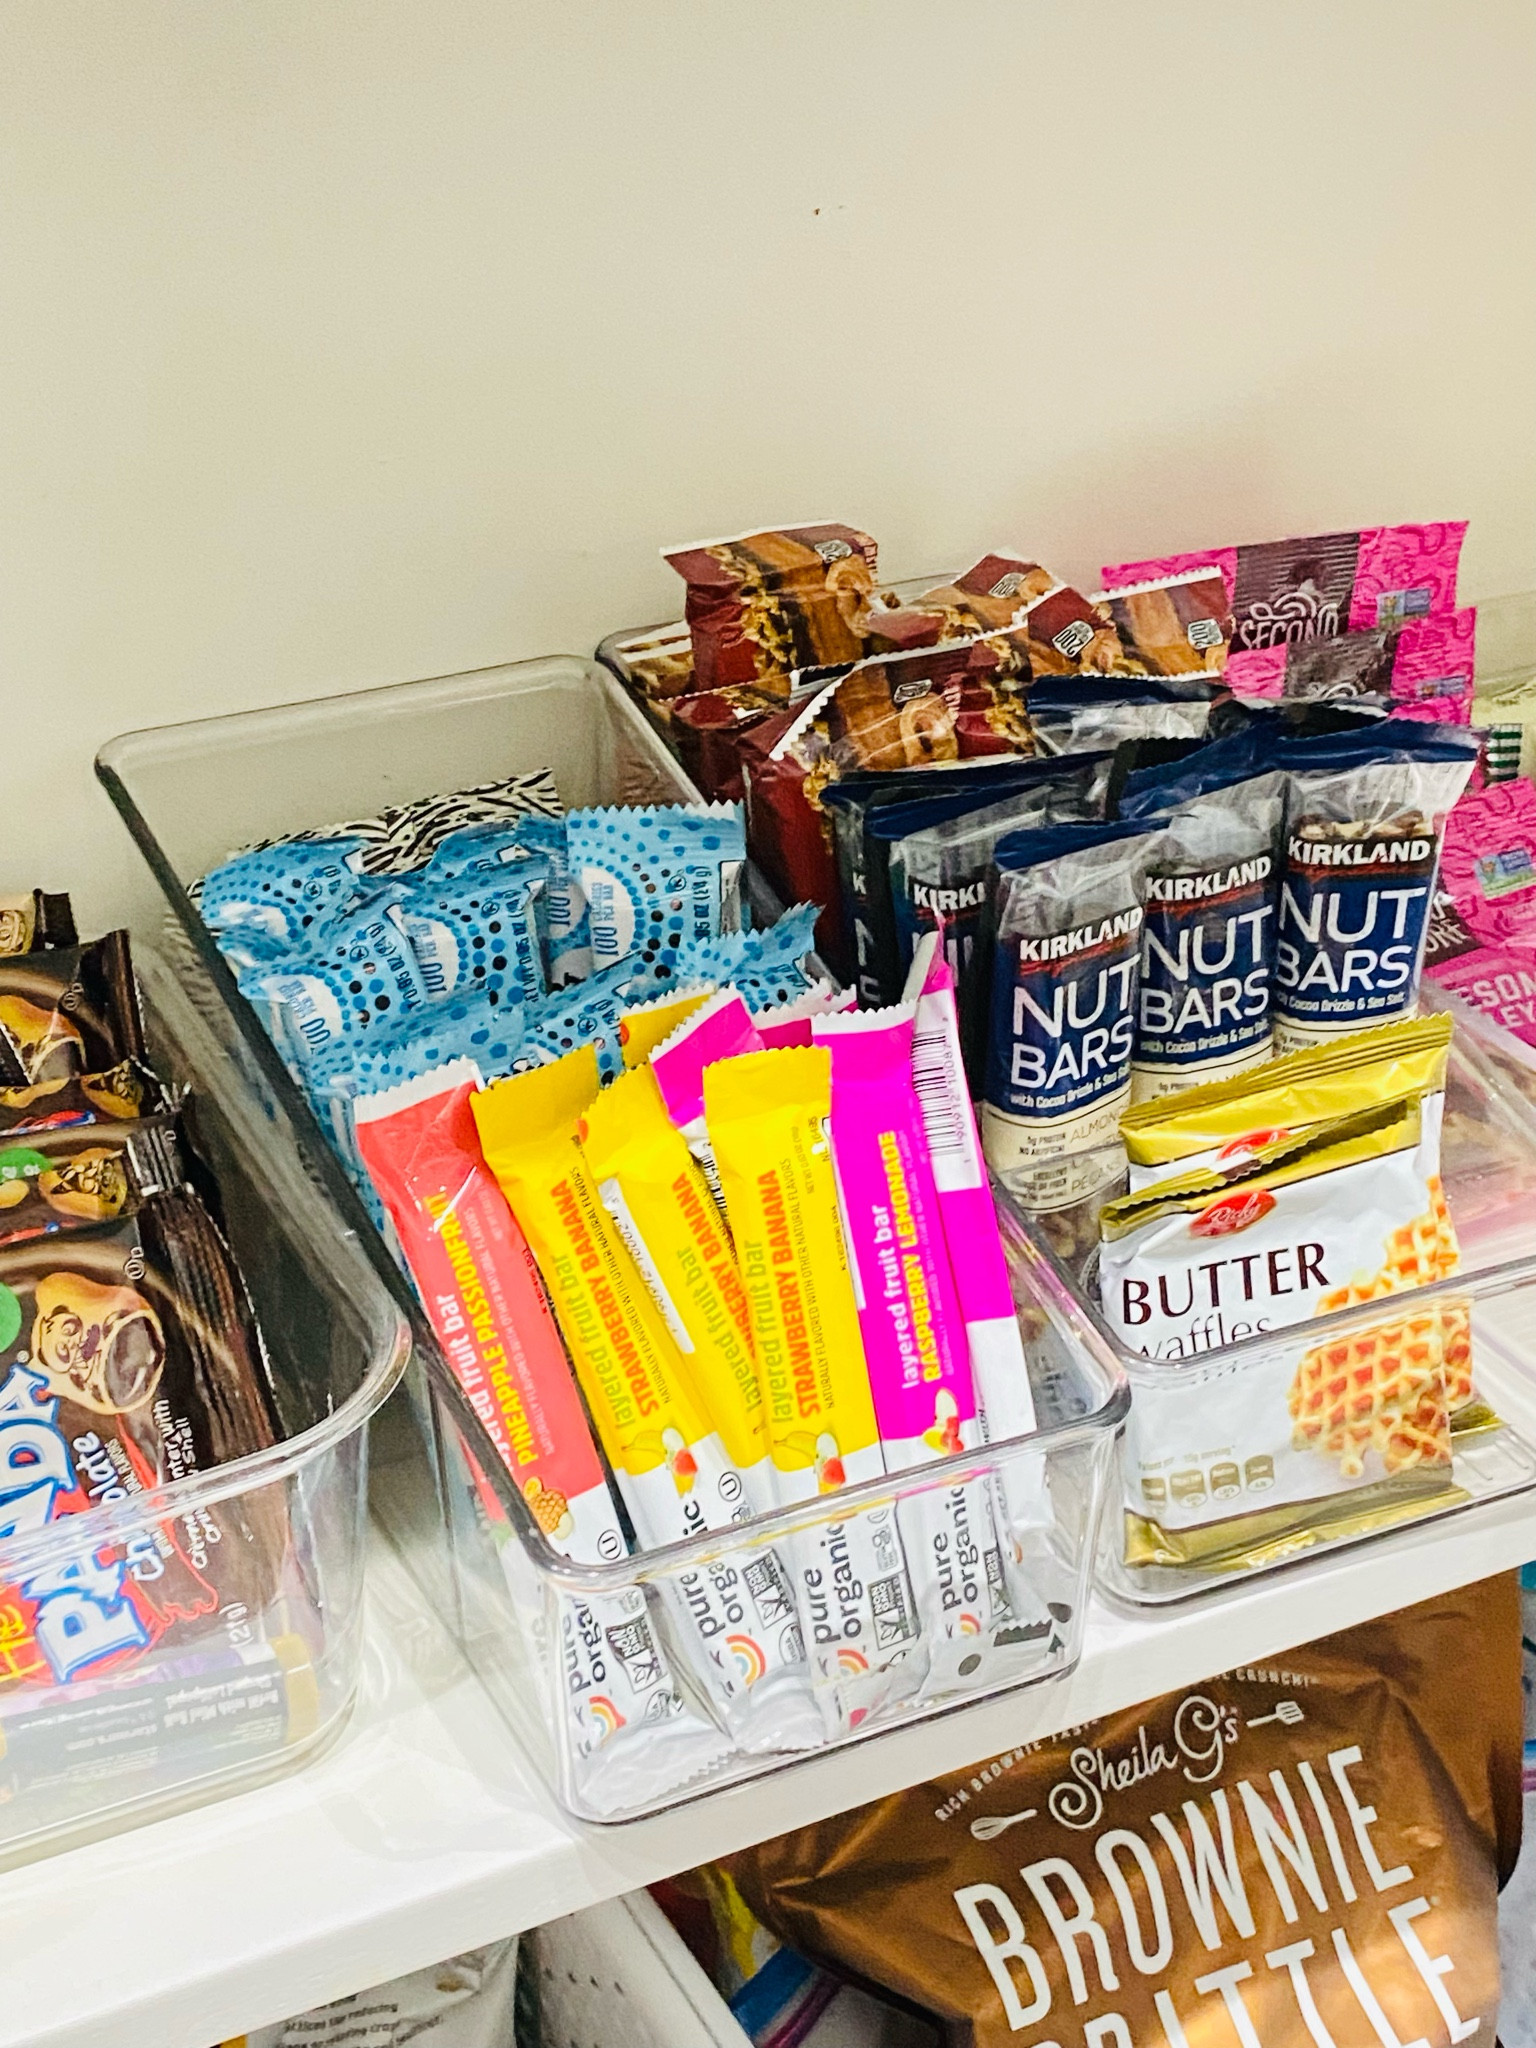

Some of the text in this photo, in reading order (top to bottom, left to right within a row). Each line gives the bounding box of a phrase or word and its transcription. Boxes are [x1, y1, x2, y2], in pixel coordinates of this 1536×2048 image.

[1055, 629, 1086, 657] 200
[1146, 856, 1274, 902] KIRKLAND
[1287, 834, 1432, 868] KIRKLAND
[593, 926, 619, 957] 100
[1020, 906, 1143, 962] KIRKLAND
[1142, 905, 1273, 985] NUT
[1281, 887, 1427, 948] NUT
[419, 962, 448, 994] 100
[1012, 953, 1142, 1039] NUT
[1140, 968, 1270, 1034] BARS
[1277, 944, 1412, 994] BARS
[1010, 1014, 1134, 1090] BARS
[1165, 1037, 1197, 1055] Cocoa
[1036, 1094, 1066, 1109] Cocoa
[568, 1166, 593, 1208] FLAVORS
[670, 1170, 723, 1263] BANANA
[878, 1129, 919, 1251] LEMONADE
[463, 1205, 490, 1249] FLAVORS
[550, 1178, 602, 1274] BANANA
[586, 1208, 611, 1251] NATURAL
[603, 1250, 622, 1282] OTHER
[616, 1281, 632, 1307] WITH
[676, 1246, 705, 1287] bar
[757, 1168, 822, 1420] STRAWBERRY BANANA
[780, 1158, 835, 1409] NATURALLY FLAVORED WITH OTHER NATURAL FLAVORS
[871, 1203, 921, 1390] layered fruit bar
[1121, 1242, 1331, 1326] BUTTER
[423, 1191, 539, 1468] PINEAPPLE PASSIONFRUIT
[436, 1293, 466, 1336] bar
[628, 1307, 653, 1355] FLAVORED
[692, 1282, 729, 1334] fruit
[743, 1239, 795, 1424] layered fruit bar
[901, 1252, 944, 1384] RASPBERRY
[448, 1333, 484, 1389] fruit
[551, 1254, 637, 1430] layered fruit bar
[586, 1275, 660, 1418] STRAWBERRY
[713, 1329, 763, 1414] layered
[646, 1355, 671, 1405] NATURALLY
[933, 1531, 963, 1612] pure
[944, 1486, 979, 1604] organic
[679, 1571, 727, 1640] pure
[744, 1567, 760, 1597] NON
[803, 1568, 842, 1645] pure
[820, 1522, 864, 1639] organic
[870, 1584, 884, 1616] NON
[878, 1580, 892, 1613] GMO
[563, 1613, 592, 1694] pure
[607, 1629, 634, 1658] NON
[934, 1738, 1043, 1823] RICH BROWNIE
[1048, 1694, 1239, 1831] Sheila G's
[953, 1745, 1416, 2032] BROWNIE
[1028, 1896, 1482, 2048] TTLE
